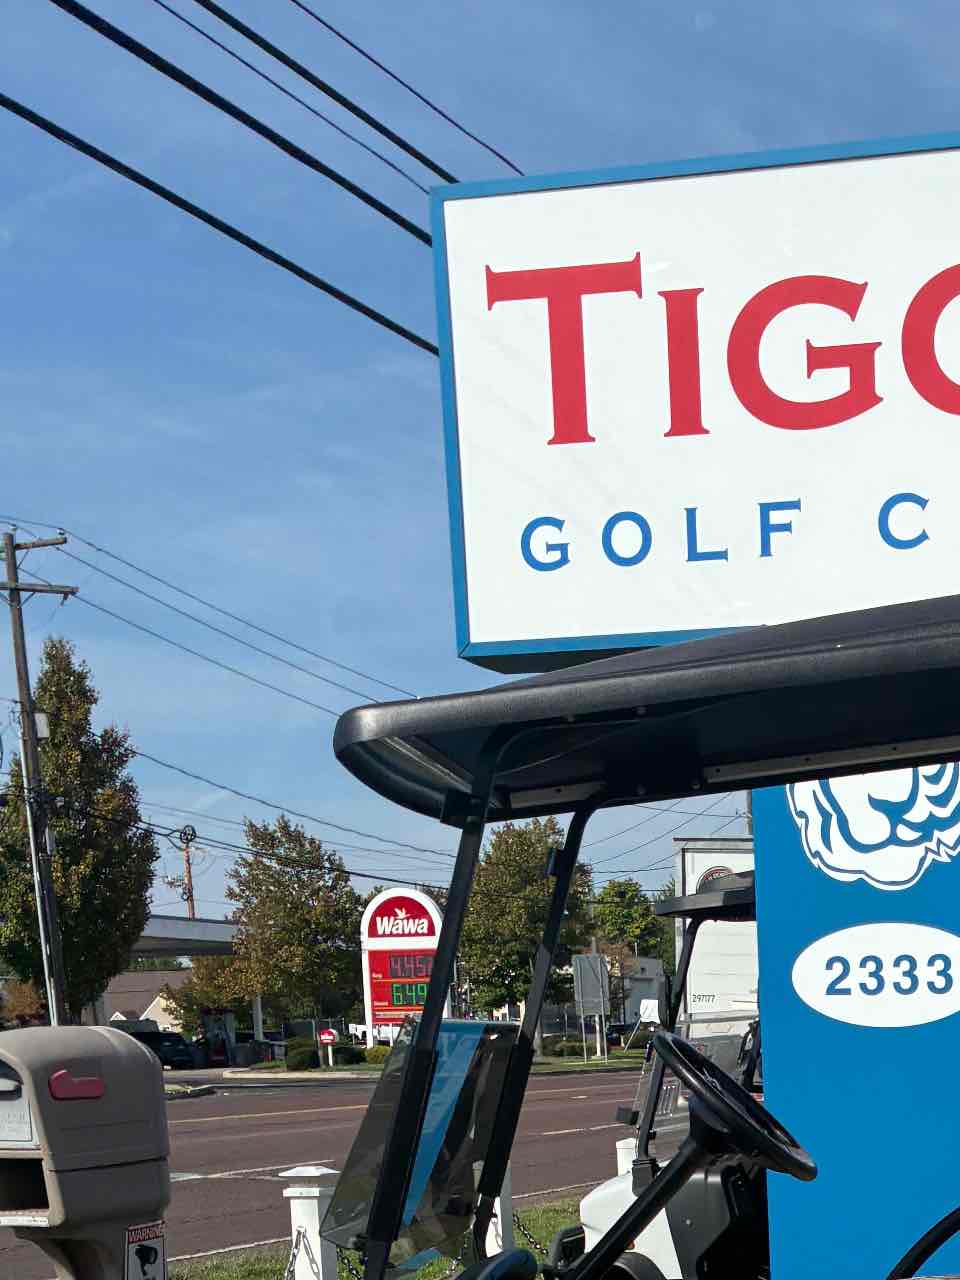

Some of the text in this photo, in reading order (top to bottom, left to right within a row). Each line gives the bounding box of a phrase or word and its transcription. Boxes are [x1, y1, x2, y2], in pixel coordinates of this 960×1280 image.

[520, 497, 801, 571] GOLF
[376, 917, 428, 934] Wawa
[825, 953, 953, 996] 2333
